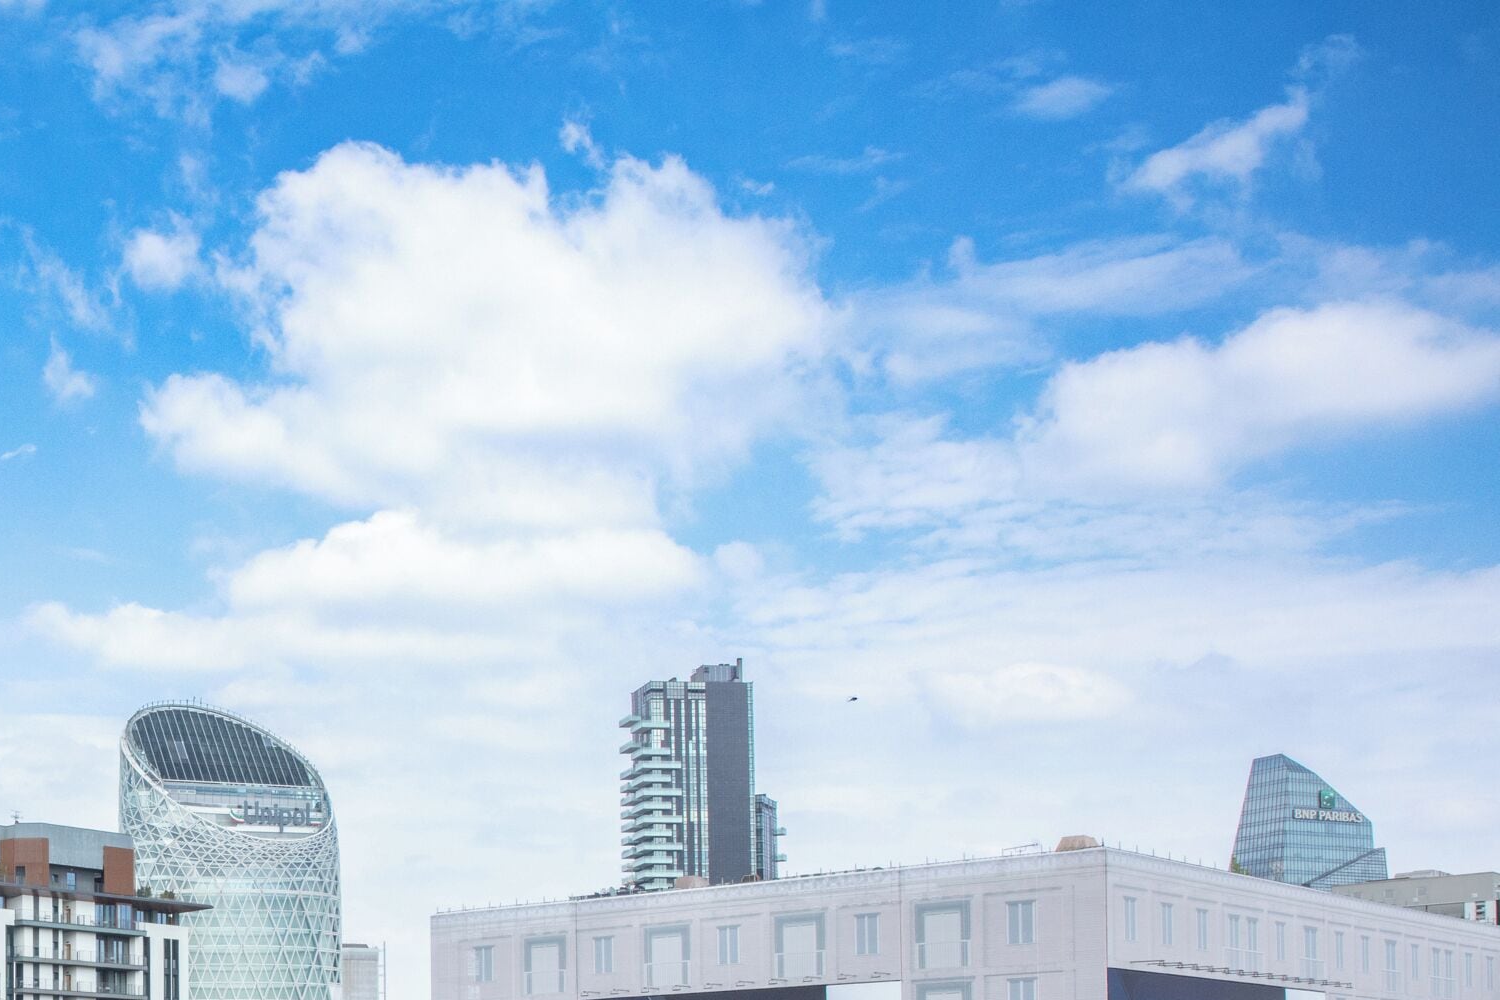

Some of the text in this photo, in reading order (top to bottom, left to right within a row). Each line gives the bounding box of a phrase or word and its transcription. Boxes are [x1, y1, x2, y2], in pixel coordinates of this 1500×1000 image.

[244, 800, 311, 833] Unipol
[1294, 809, 1363, 823] BNP PARIBAS
